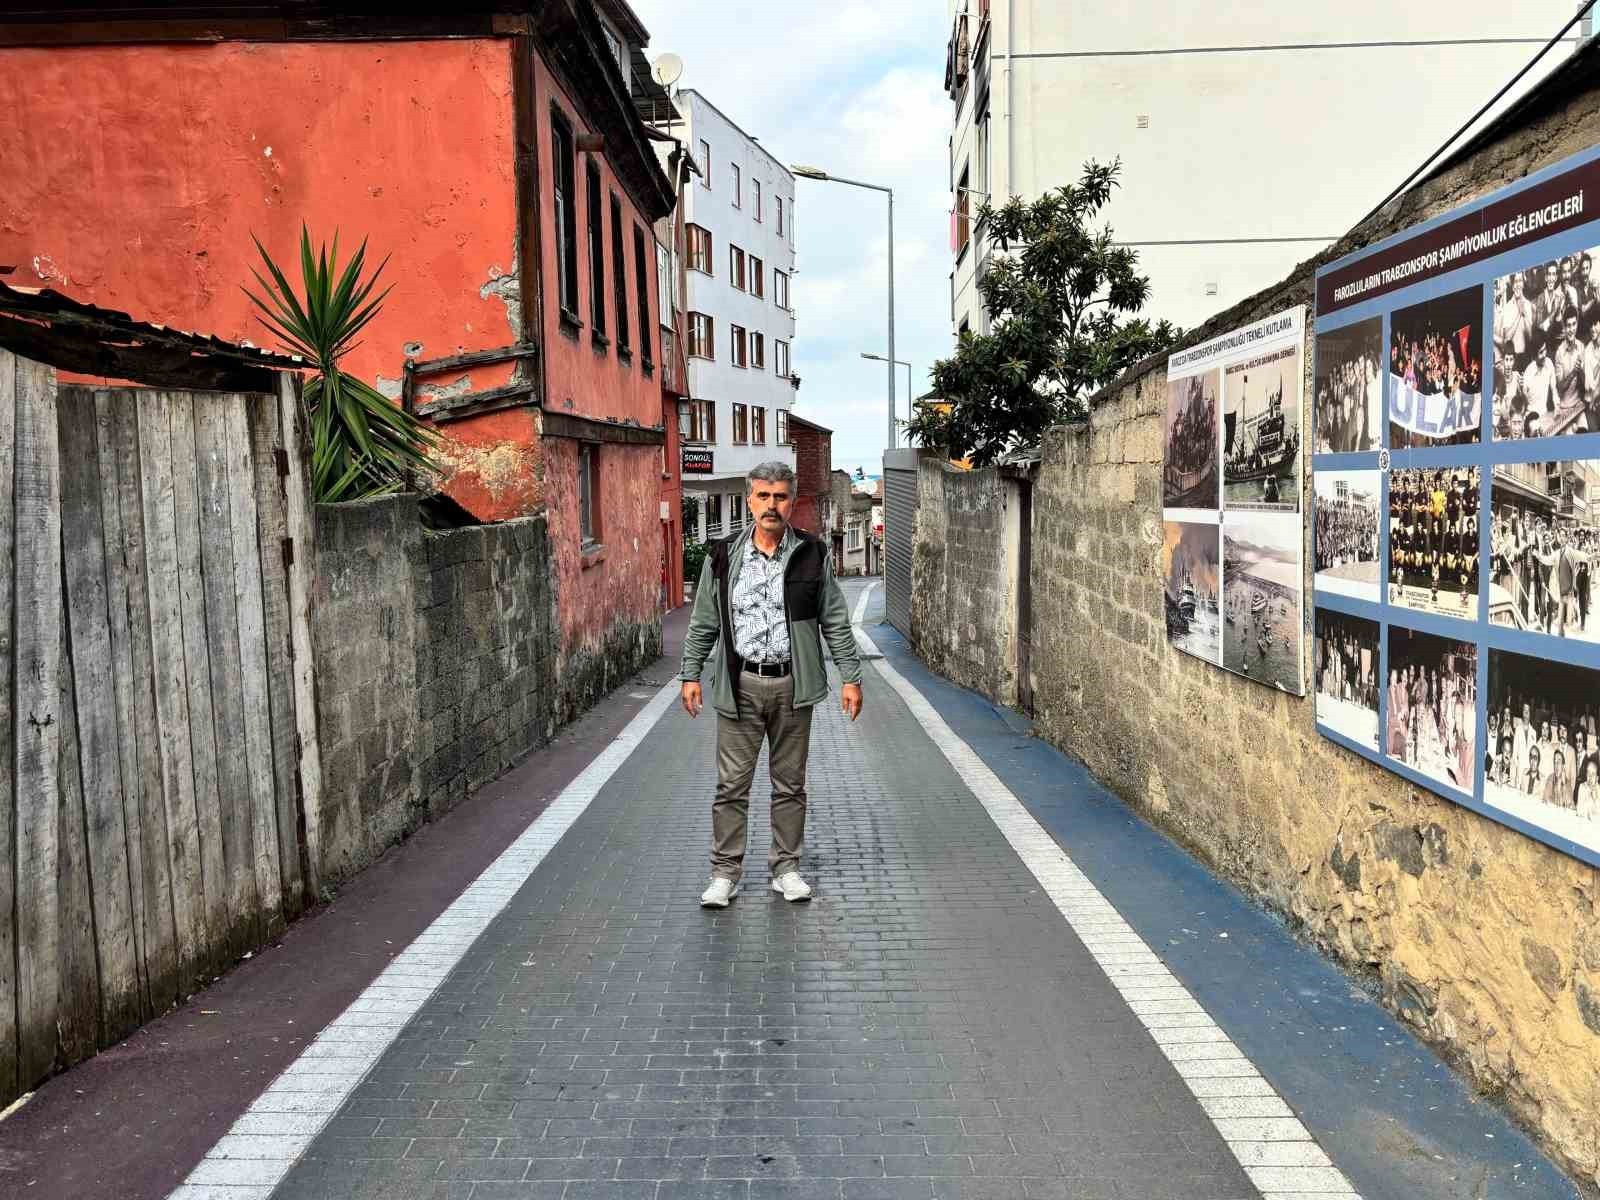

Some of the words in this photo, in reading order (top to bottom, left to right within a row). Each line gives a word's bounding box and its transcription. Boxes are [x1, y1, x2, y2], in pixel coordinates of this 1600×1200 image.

[1334, 272, 1381, 302] FAROZLULARIN
[1381, 251, 1439, 285] TRABZONSPOR
[1439, 223, 1508, 269] ŞAMPİYONLUK
[1508, 189, 1584, 239] EĞLENCELERİ
[1246, 323, 1265, 344] TEKNELİ
[1265, 316, 1292, 337] KUTLAMA
